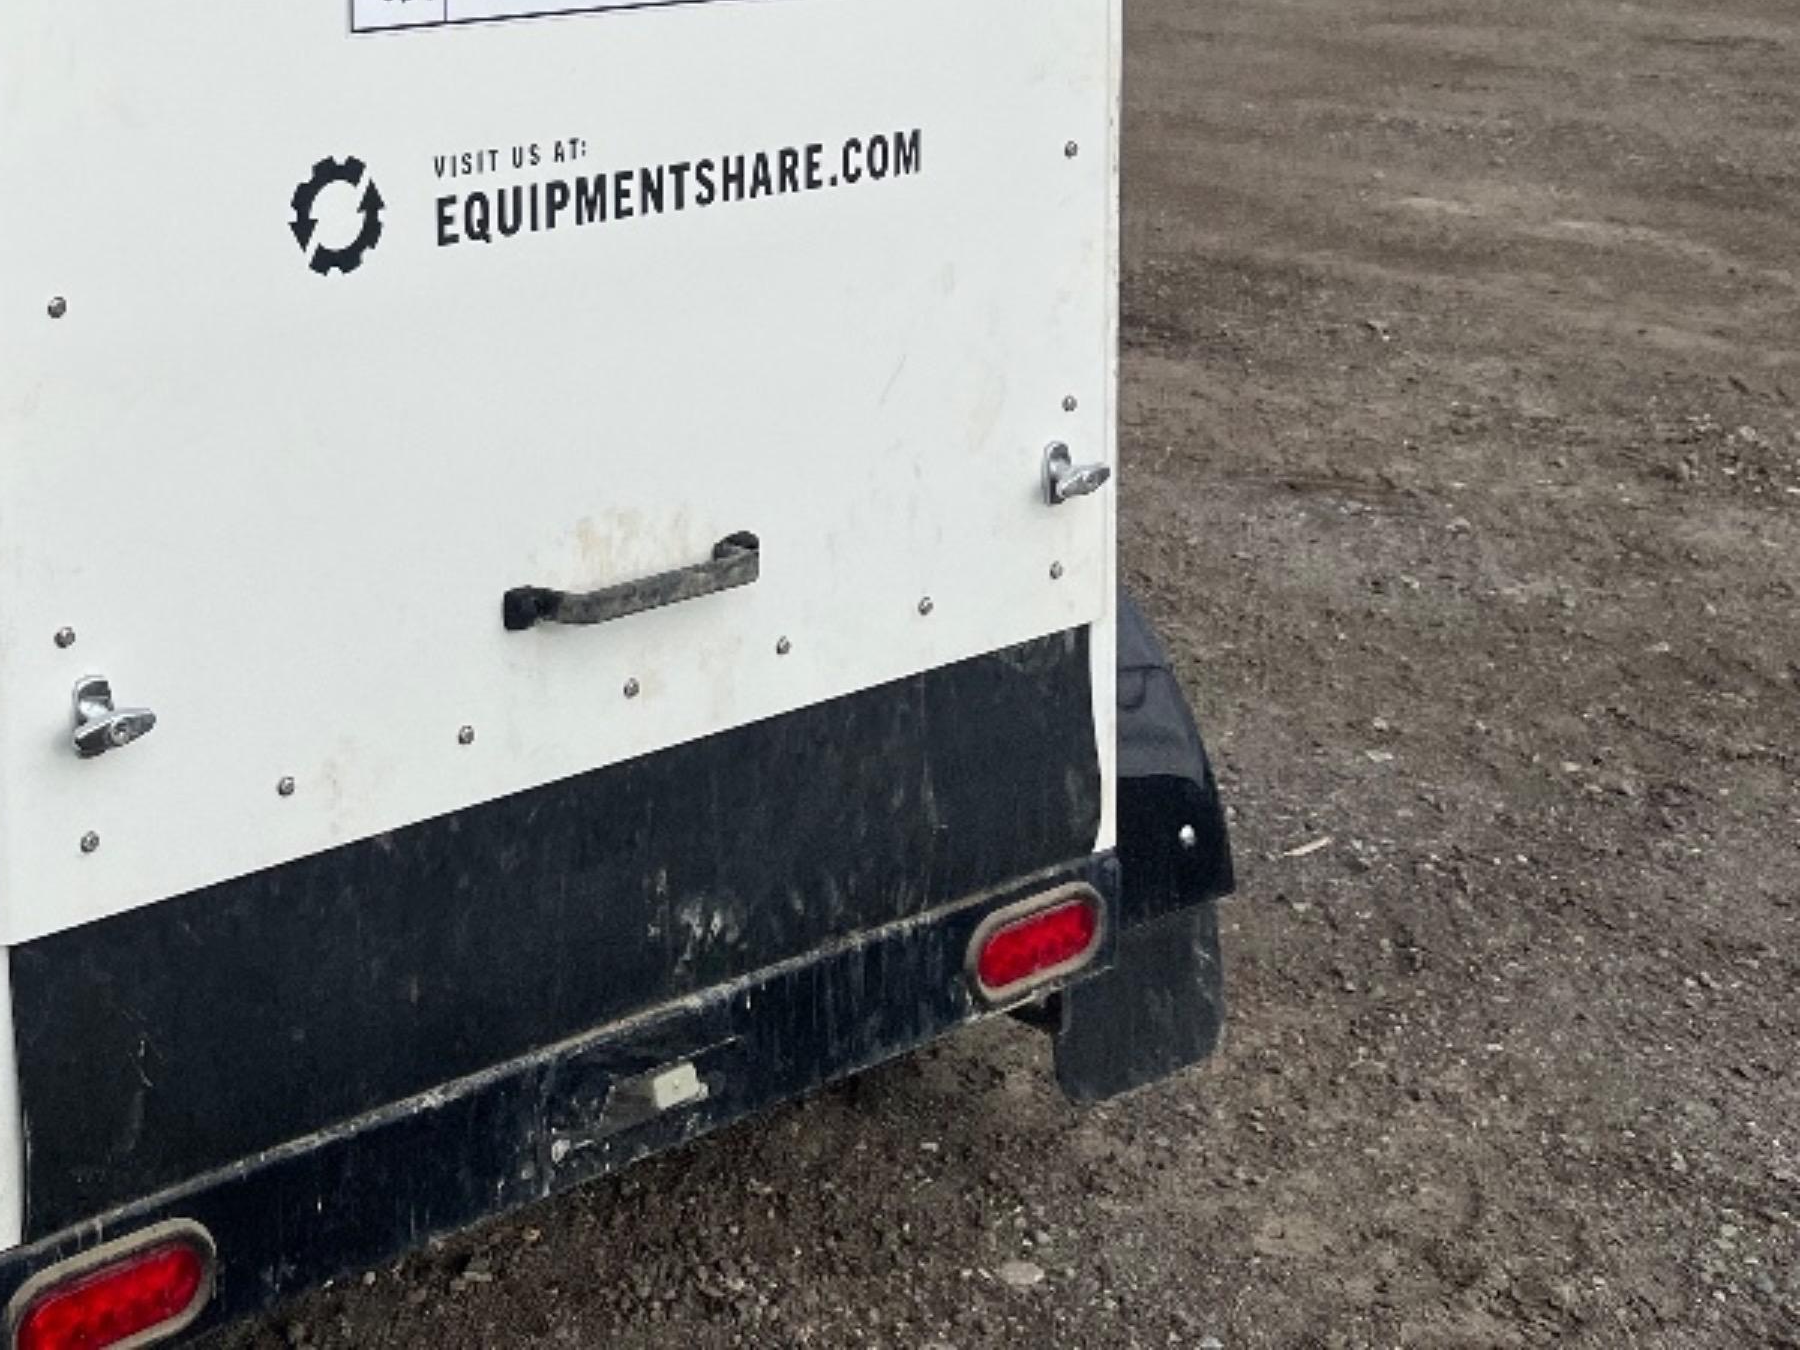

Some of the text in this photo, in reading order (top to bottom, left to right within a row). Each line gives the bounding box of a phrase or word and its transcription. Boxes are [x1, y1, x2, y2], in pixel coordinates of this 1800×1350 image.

[433, 137, 587, 178] VISIT US AT:
[435, 128, 922, 247] EQUIPMENTSHARE.COM
